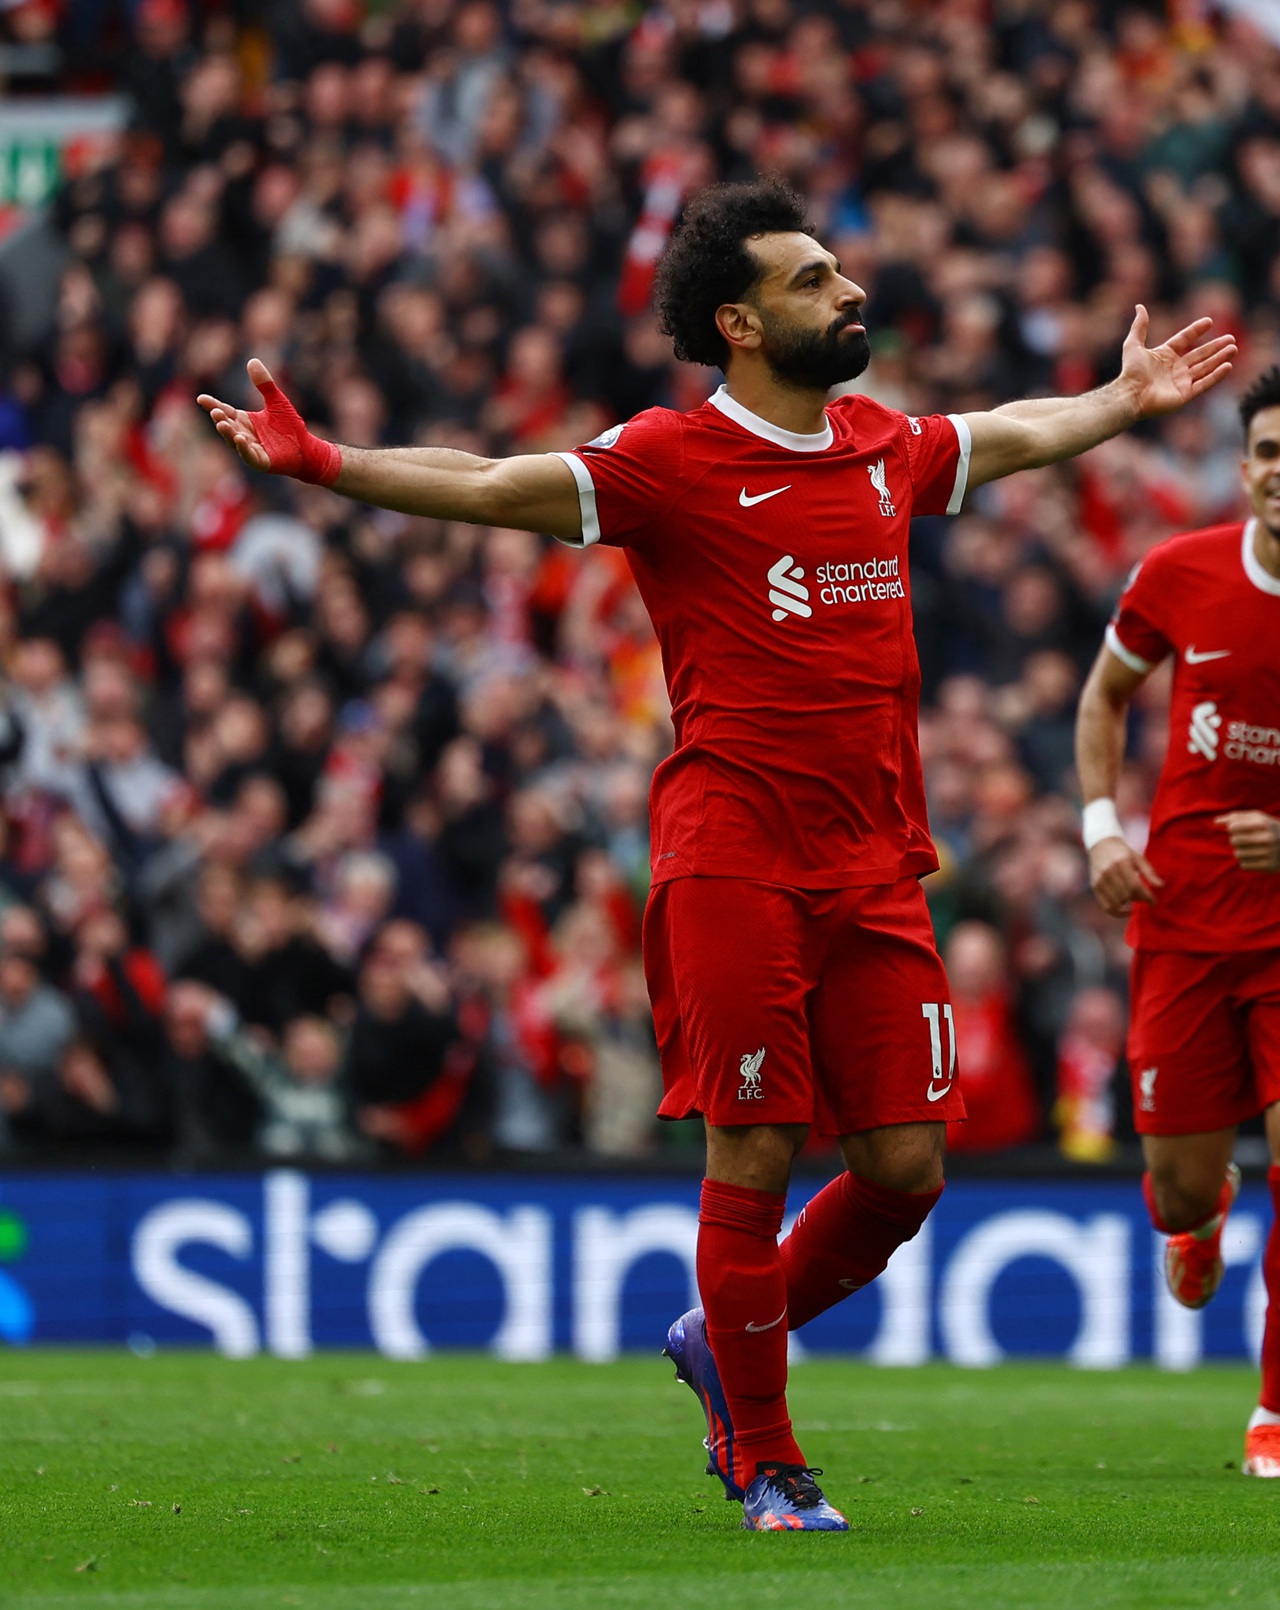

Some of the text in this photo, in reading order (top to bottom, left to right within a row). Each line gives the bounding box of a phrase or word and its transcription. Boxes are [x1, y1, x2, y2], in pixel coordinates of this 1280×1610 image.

[816, 555, 899, 583] standard
[820, 577, 905, 605] chartered
[921, 1003, 955, 1079] 11
